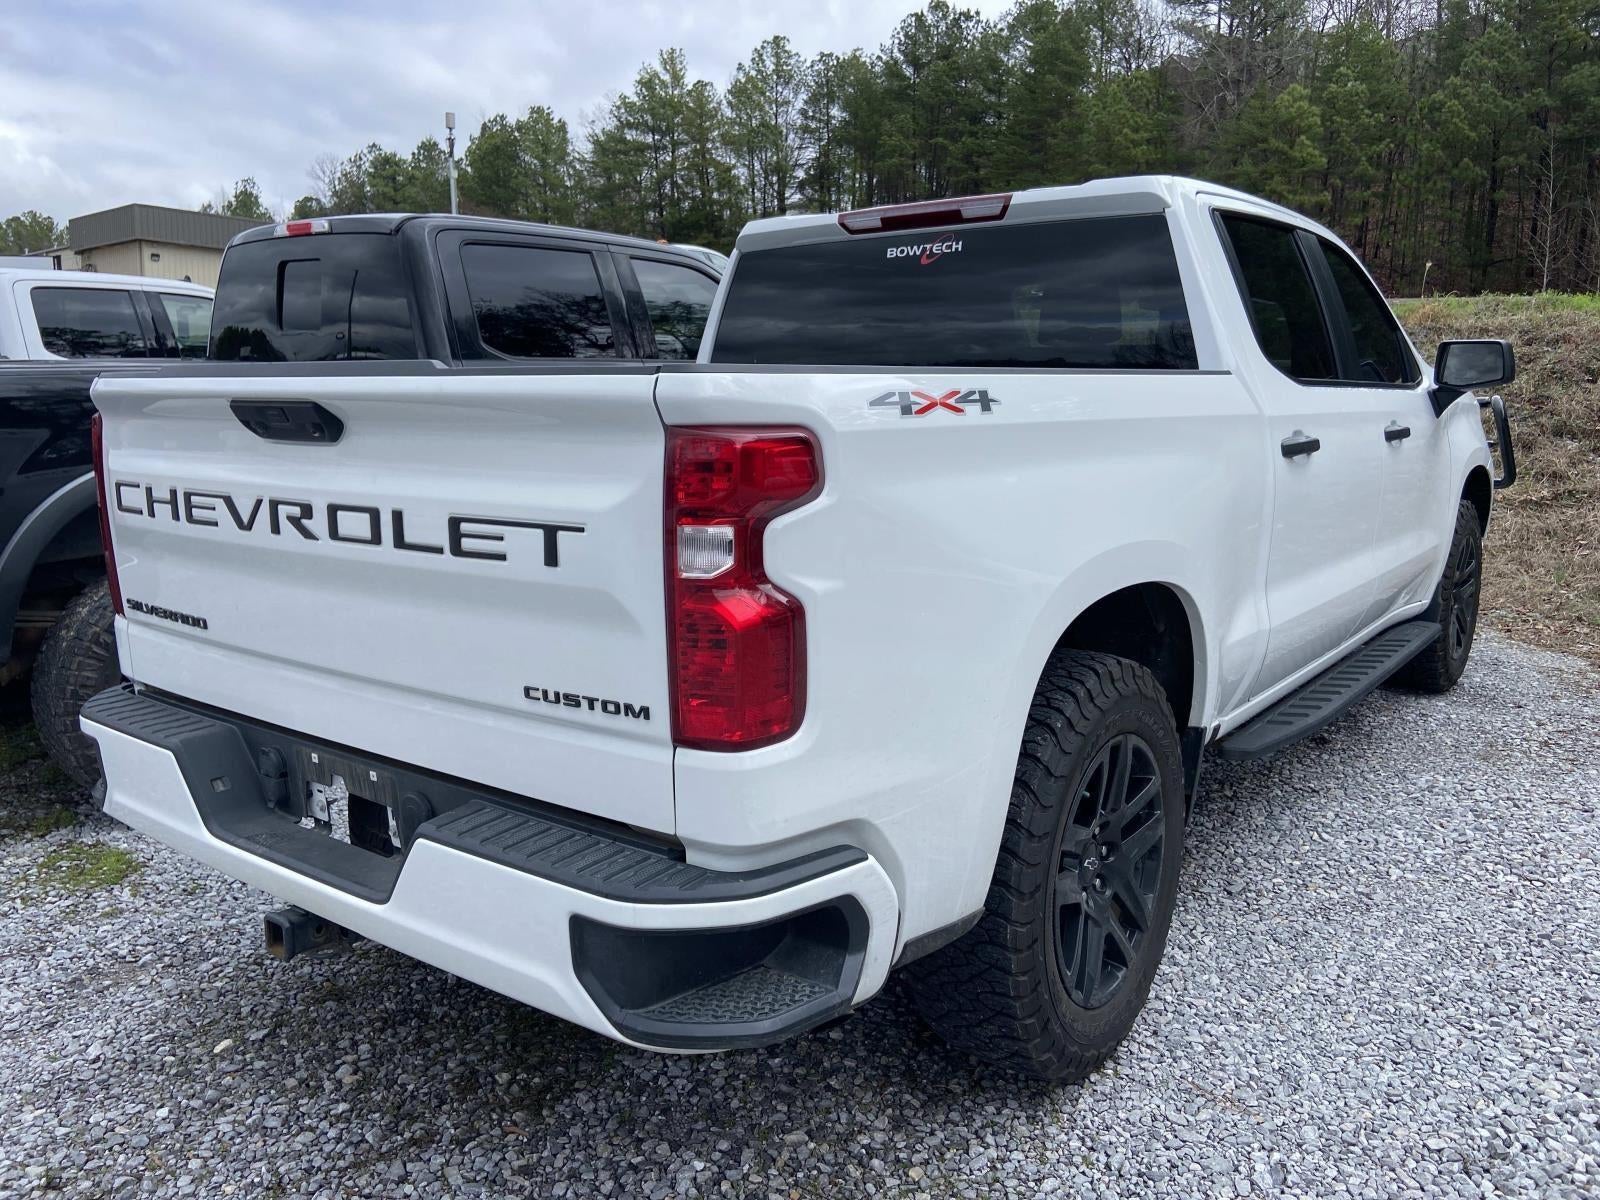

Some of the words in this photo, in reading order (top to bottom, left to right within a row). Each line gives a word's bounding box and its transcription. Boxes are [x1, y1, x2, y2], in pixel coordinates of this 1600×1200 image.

[887, 241, 963, 258] BOWTECH
[114, 481, 586, 568] CHEVROLET
[126, 598, 208, 630] SILVERADO
[523, 685, 651, 721] CUSTOM
